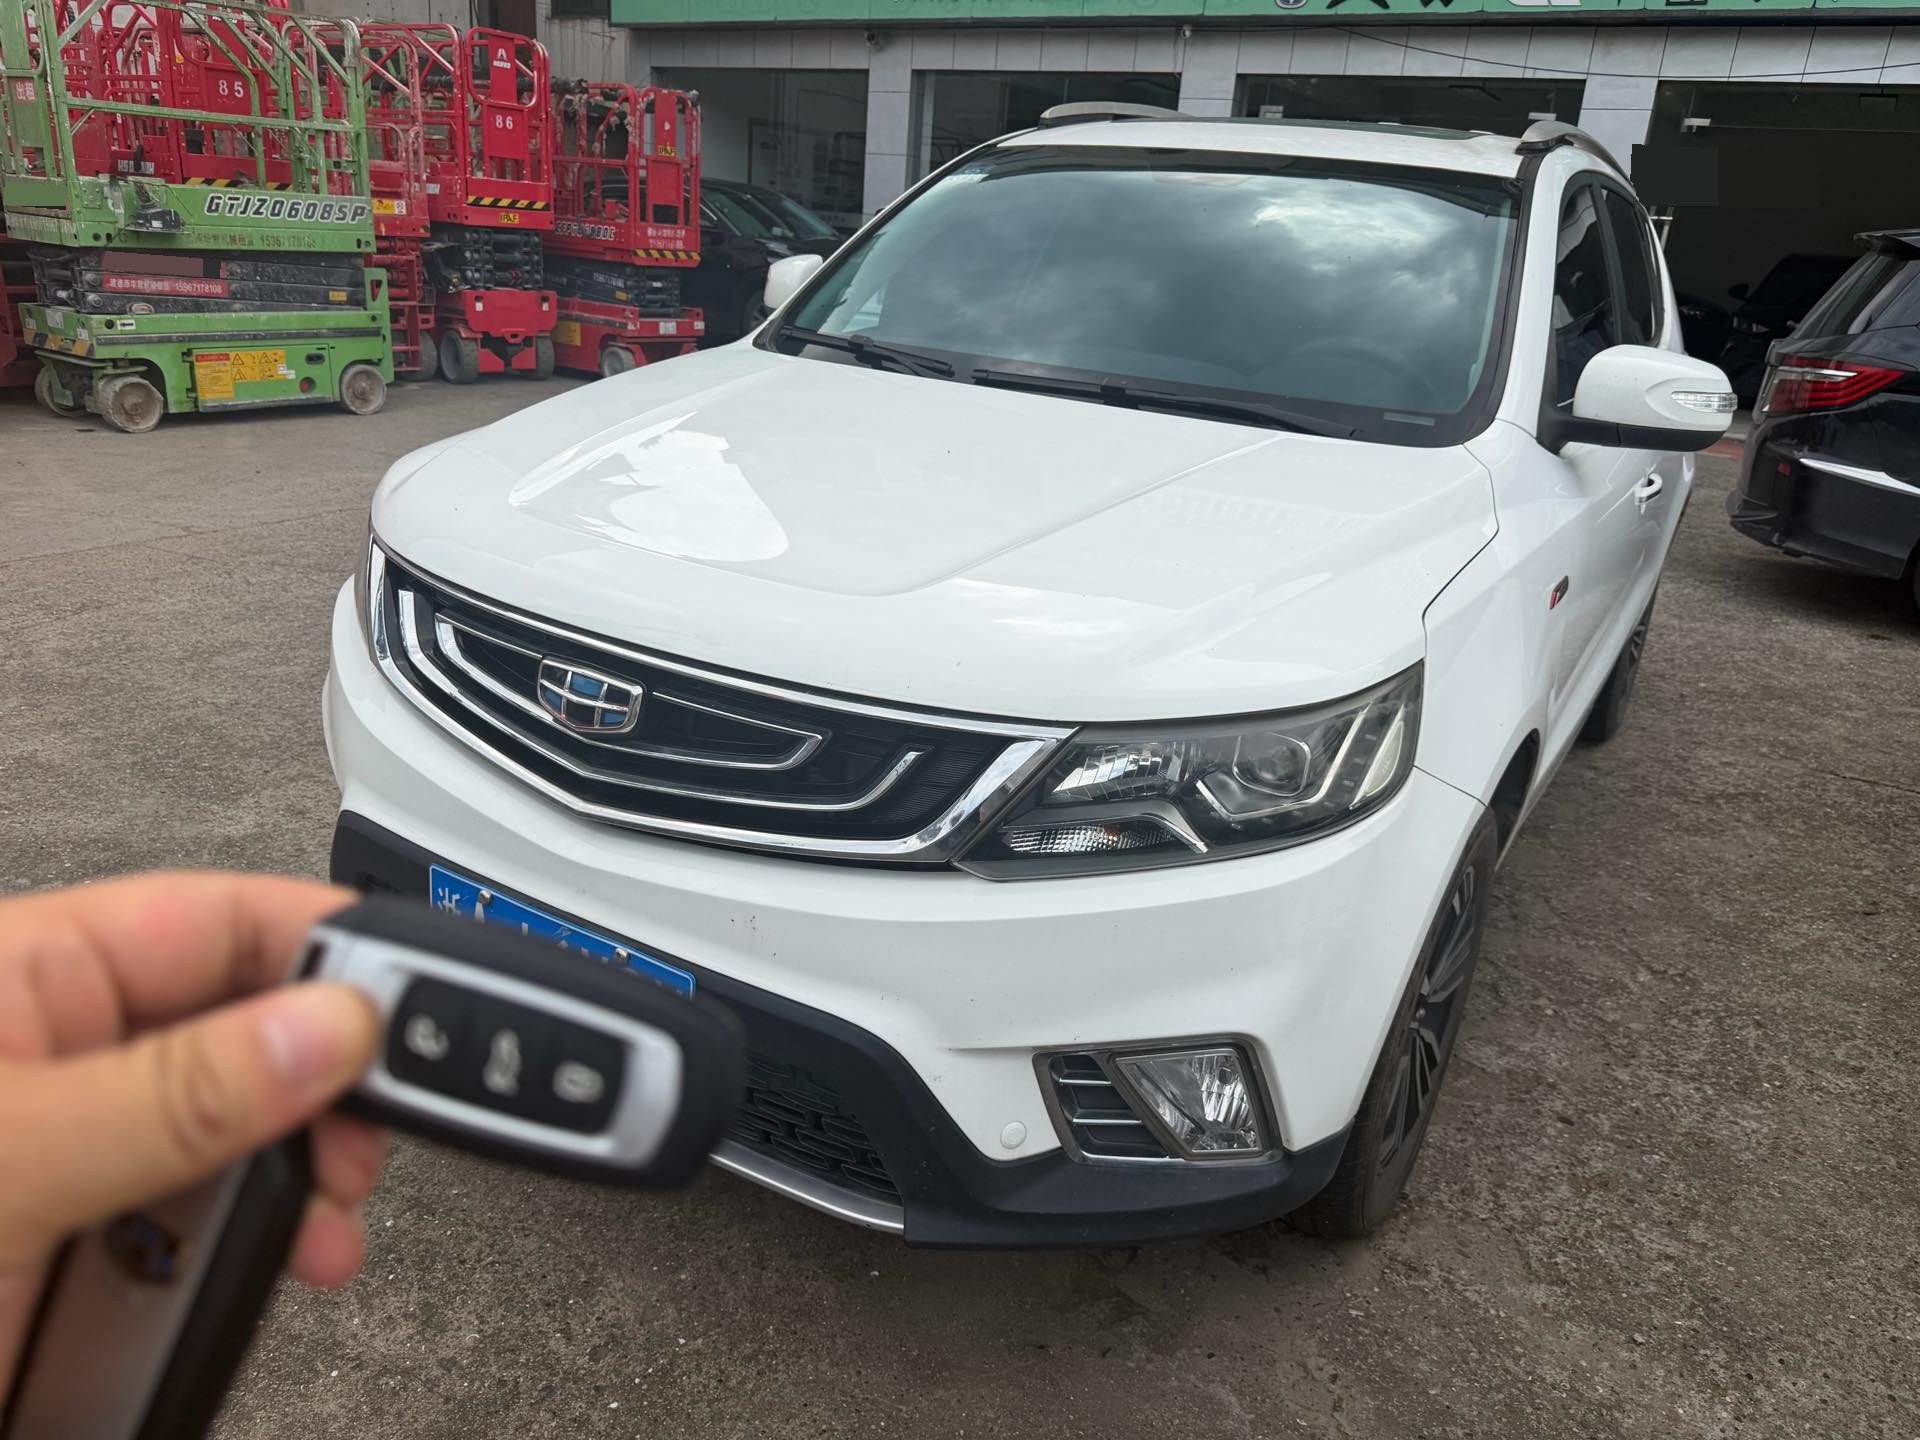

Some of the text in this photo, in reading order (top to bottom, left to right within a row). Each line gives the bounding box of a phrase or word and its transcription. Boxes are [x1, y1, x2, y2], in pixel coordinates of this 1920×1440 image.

[219, 80, 244, 98] 85
[495, 114, 513, 130] 86
[205, 193, 369, 224] GTJZ0608SP
